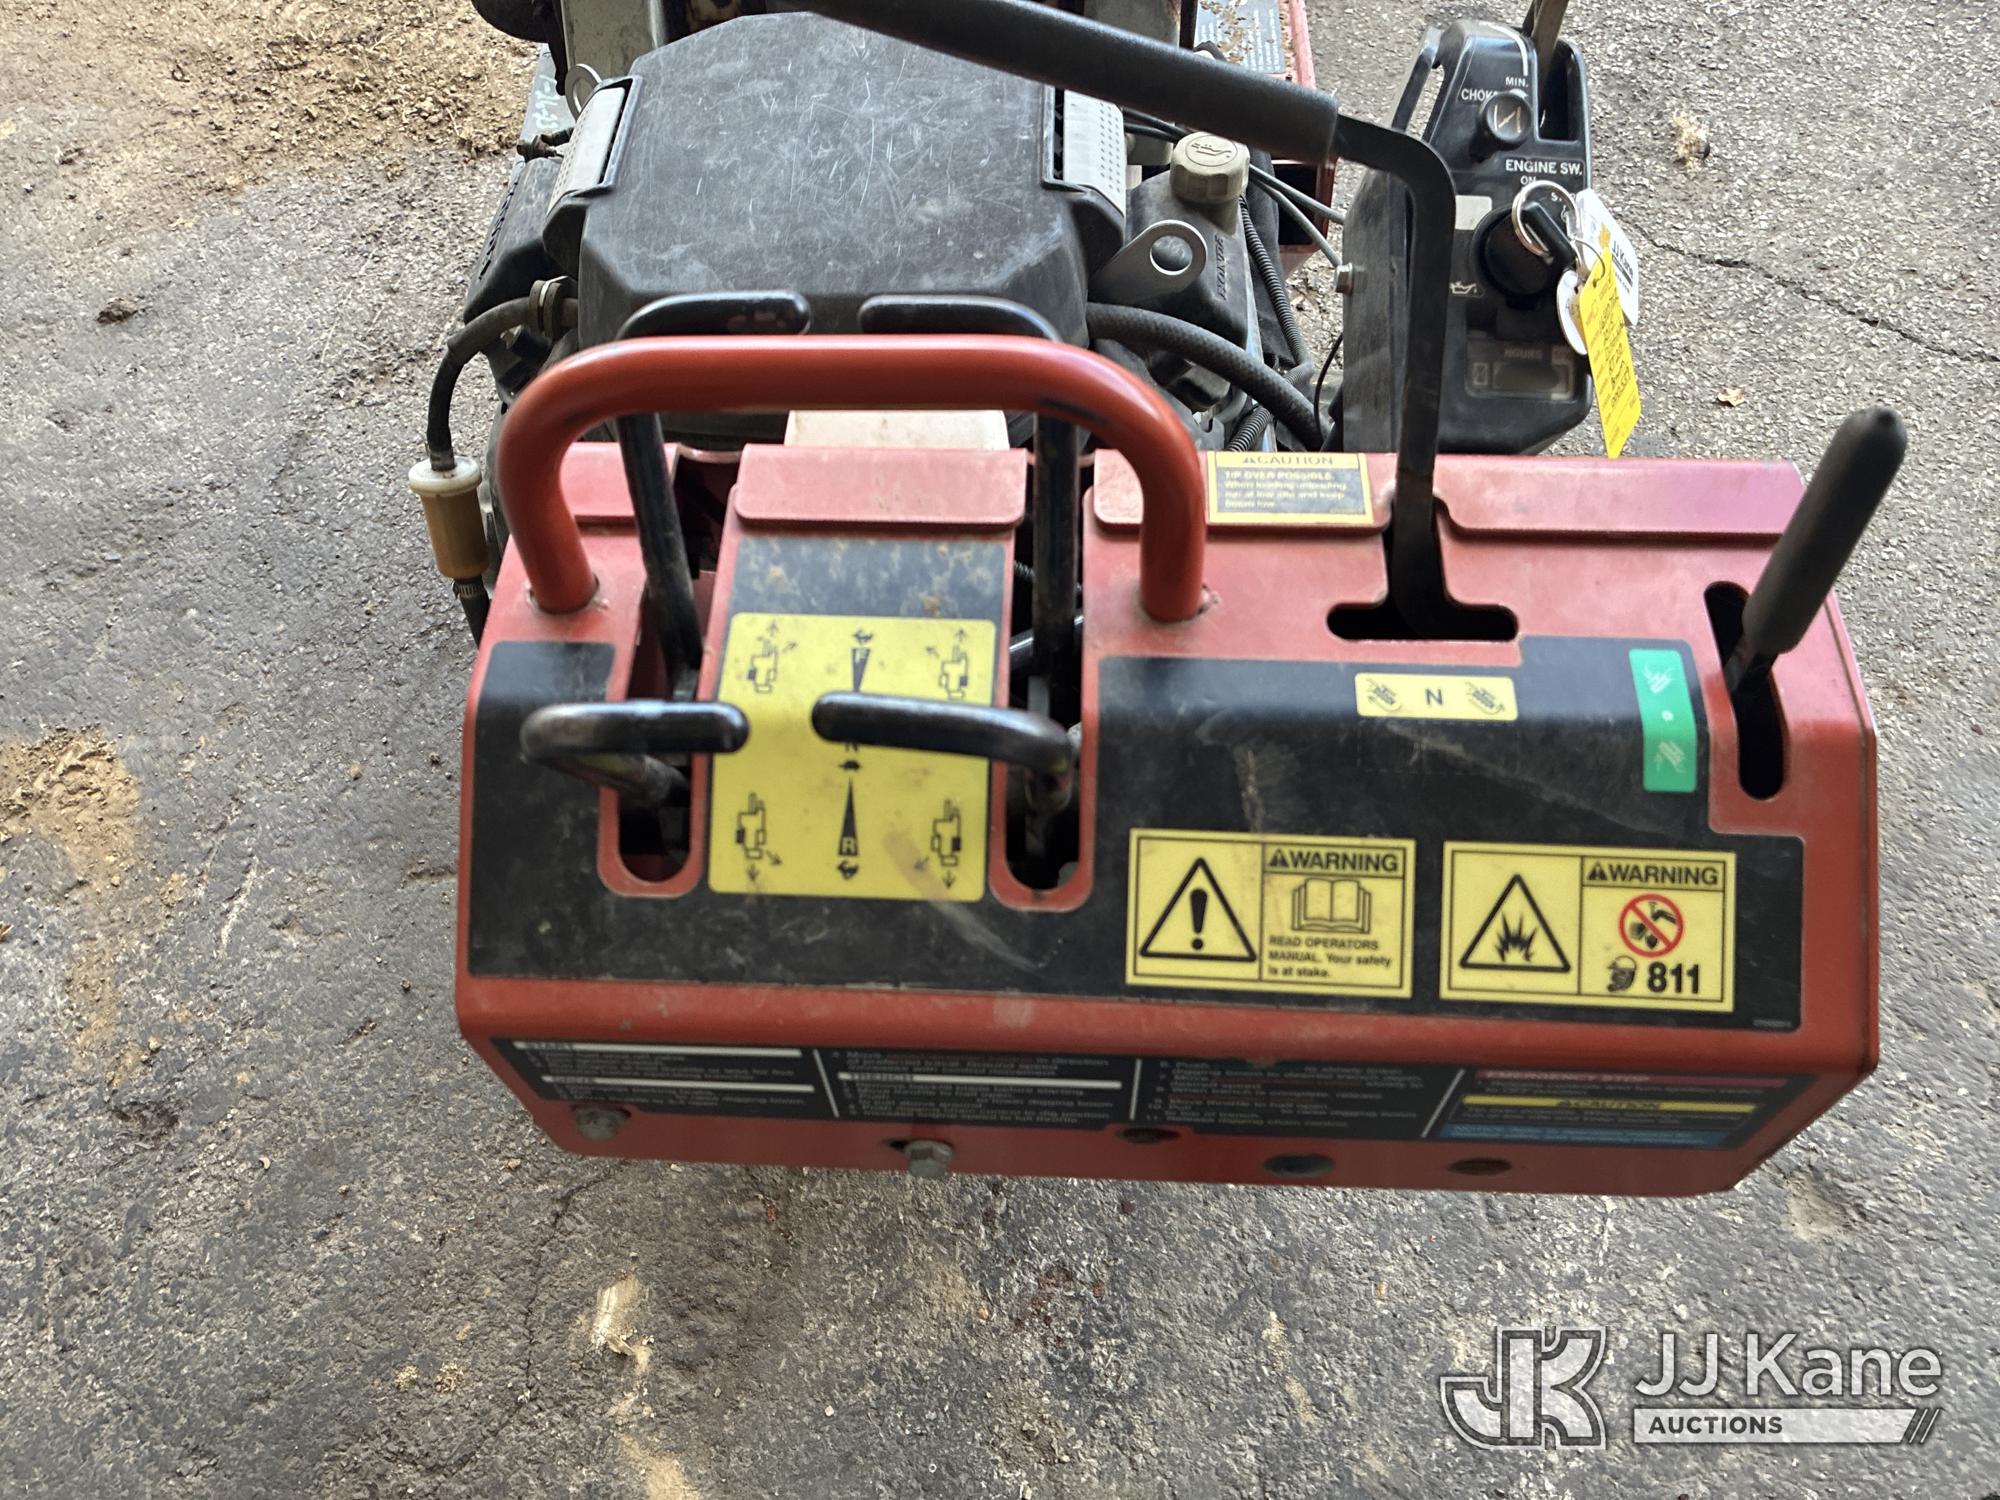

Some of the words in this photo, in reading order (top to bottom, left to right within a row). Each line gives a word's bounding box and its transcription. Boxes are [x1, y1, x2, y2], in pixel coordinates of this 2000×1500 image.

[1505, 76, 1529, 88] MIN.
[1461, 88, 1497, 102] CHOK
[1505, 159, 1557, 174] ENGINE
[1560, 163, 1583, 176] SW.
[1258, 456, 1334, 466] CAUTION
[1225, 471, 1241, 480] TIP
[1244, 471, 1275, 480] OVER
[1424, 688, 1444, 706] N
[842, 836, 855, 853] R
[1290, 851, 1398, 872] WARNING
[1608, 863, 1718, 885] WARNING
[1269, 935, 1302, 947] READ
[1305, 937, 1379, 949] OPERATORS
[1326, 953, 1352, 964] Your
[1356, 954, 1391, 967] safety
[1282, 966, 1294, 976] at
[1647, 961, 1699, 994] 811
